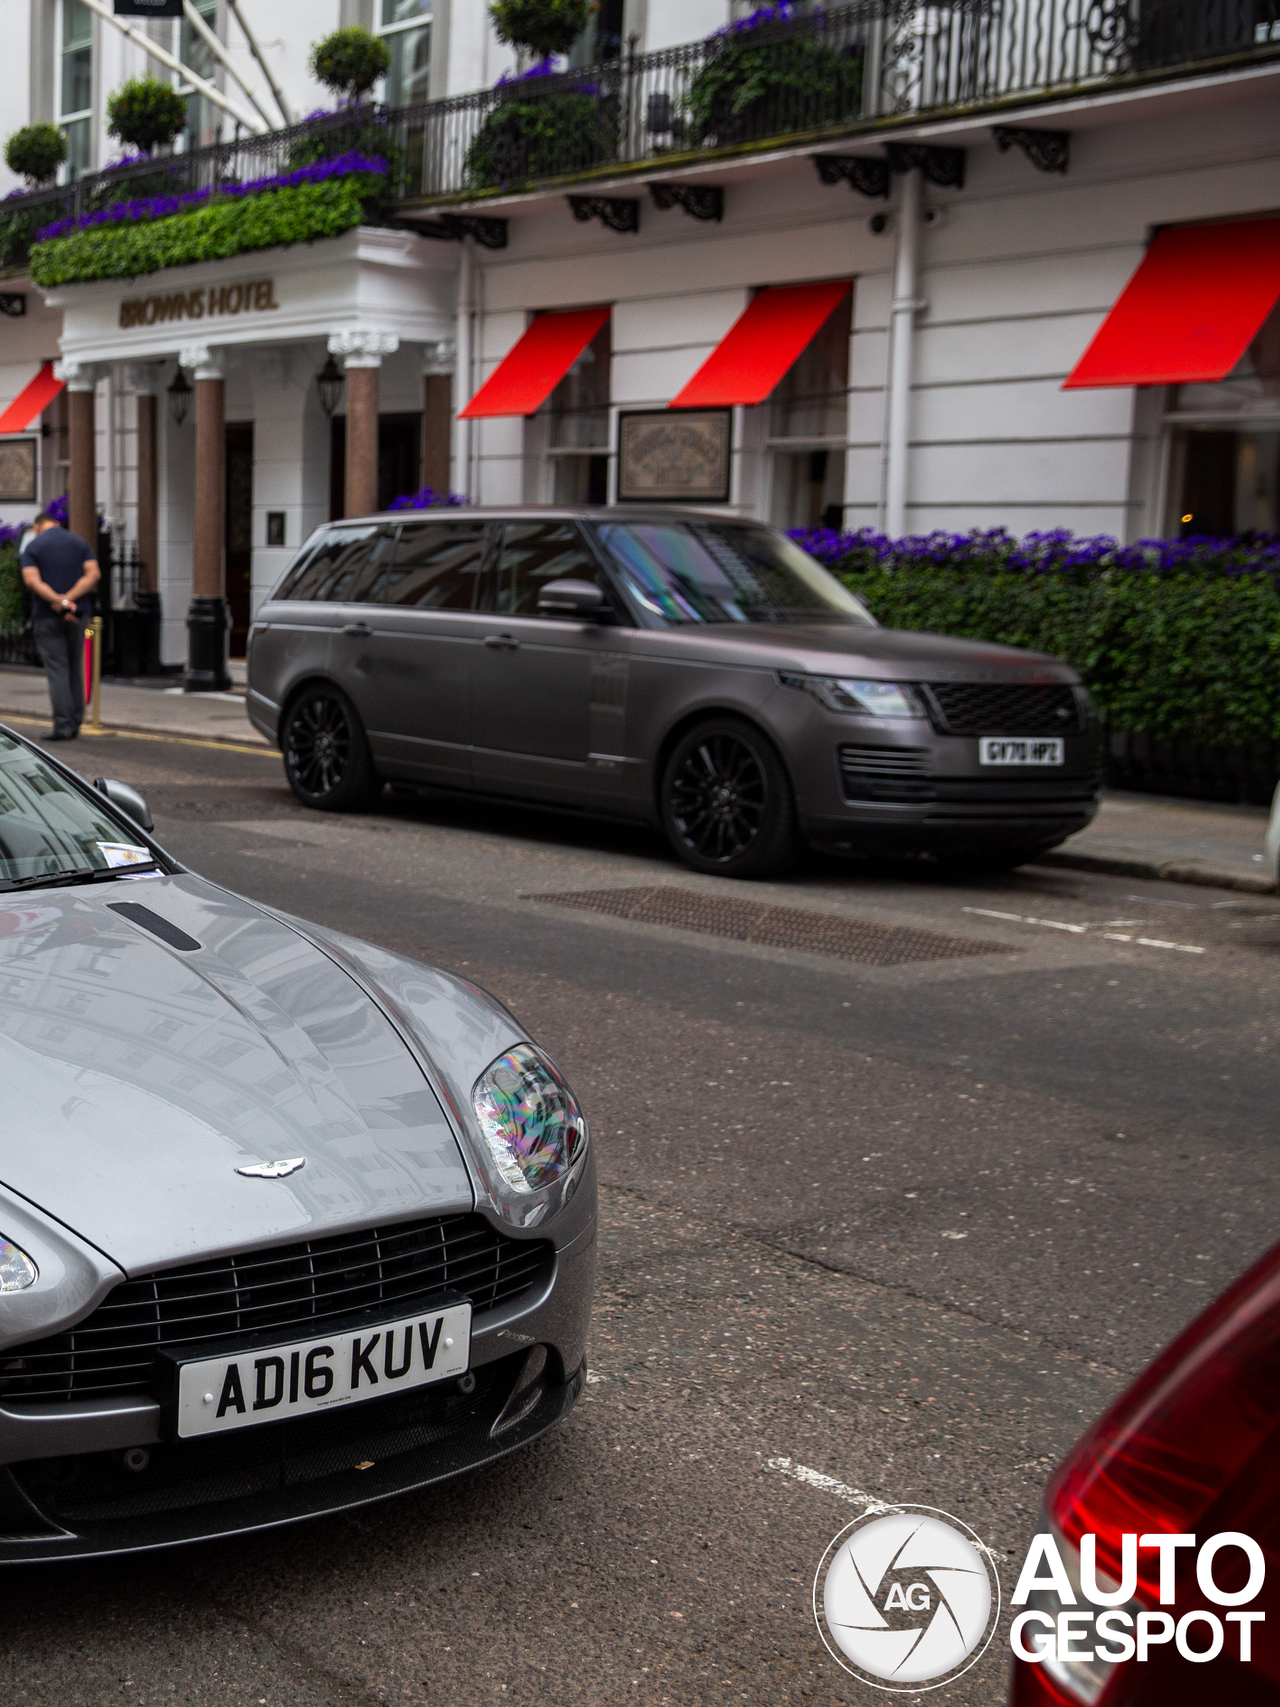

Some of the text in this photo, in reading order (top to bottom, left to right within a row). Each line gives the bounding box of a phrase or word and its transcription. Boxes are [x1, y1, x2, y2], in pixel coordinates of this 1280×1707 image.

[119, 278, 279, 329] BROWNS HOTEL
[215, 1317, 444, 1419] AD16 KUV
